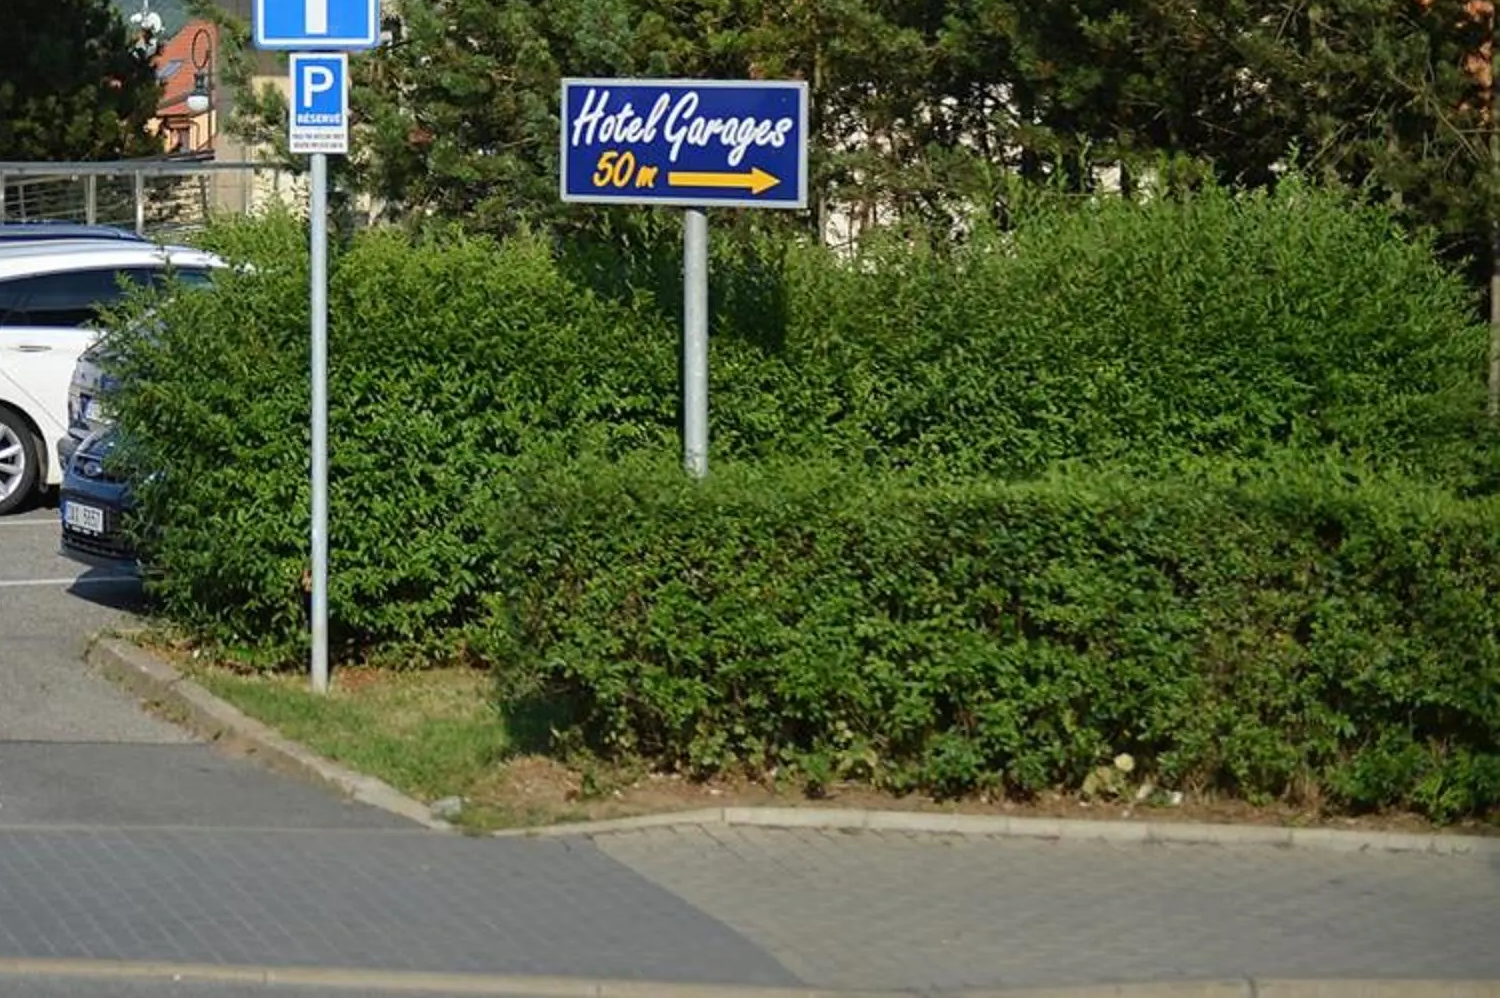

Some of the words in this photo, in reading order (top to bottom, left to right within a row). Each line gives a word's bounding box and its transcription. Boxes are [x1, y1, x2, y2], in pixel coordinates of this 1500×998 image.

[304, 66, 334, 107] P
[572, 88, 670, 146] Hotel
[664, 91, 793, 167] Garages
[593, 151, 636, 187] 50
[635, 165, 658, 187] m
